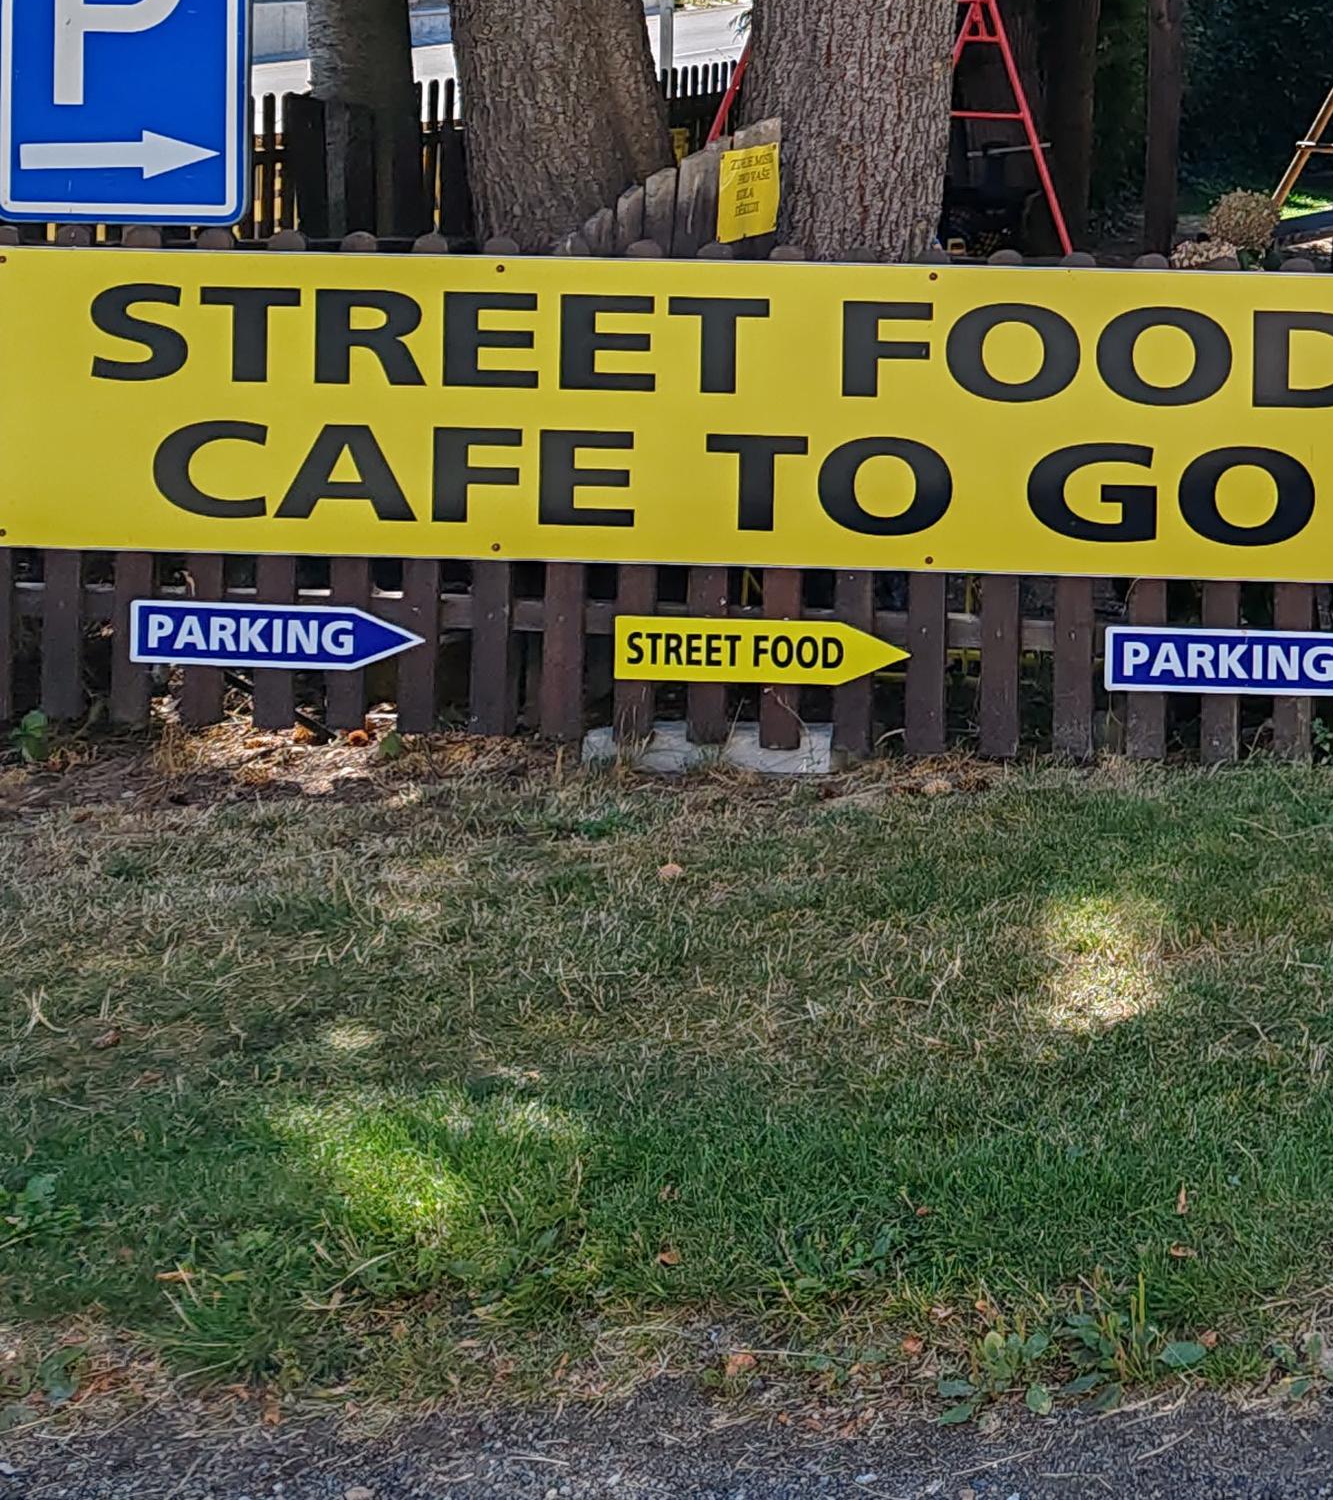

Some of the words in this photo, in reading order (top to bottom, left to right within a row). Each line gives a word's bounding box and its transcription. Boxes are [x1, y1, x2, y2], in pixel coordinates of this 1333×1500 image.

[90, 282, 770, 395] STREET
[152, 419, 635, 528] CAFE
[705, 433, 953, 537] TO
[1026, 442, 1316, 547] GO
[147, 613, 355, 656] PARKING
[627, 631, 739, 668] STREET
[752, 635, 844, 669] FOOD
